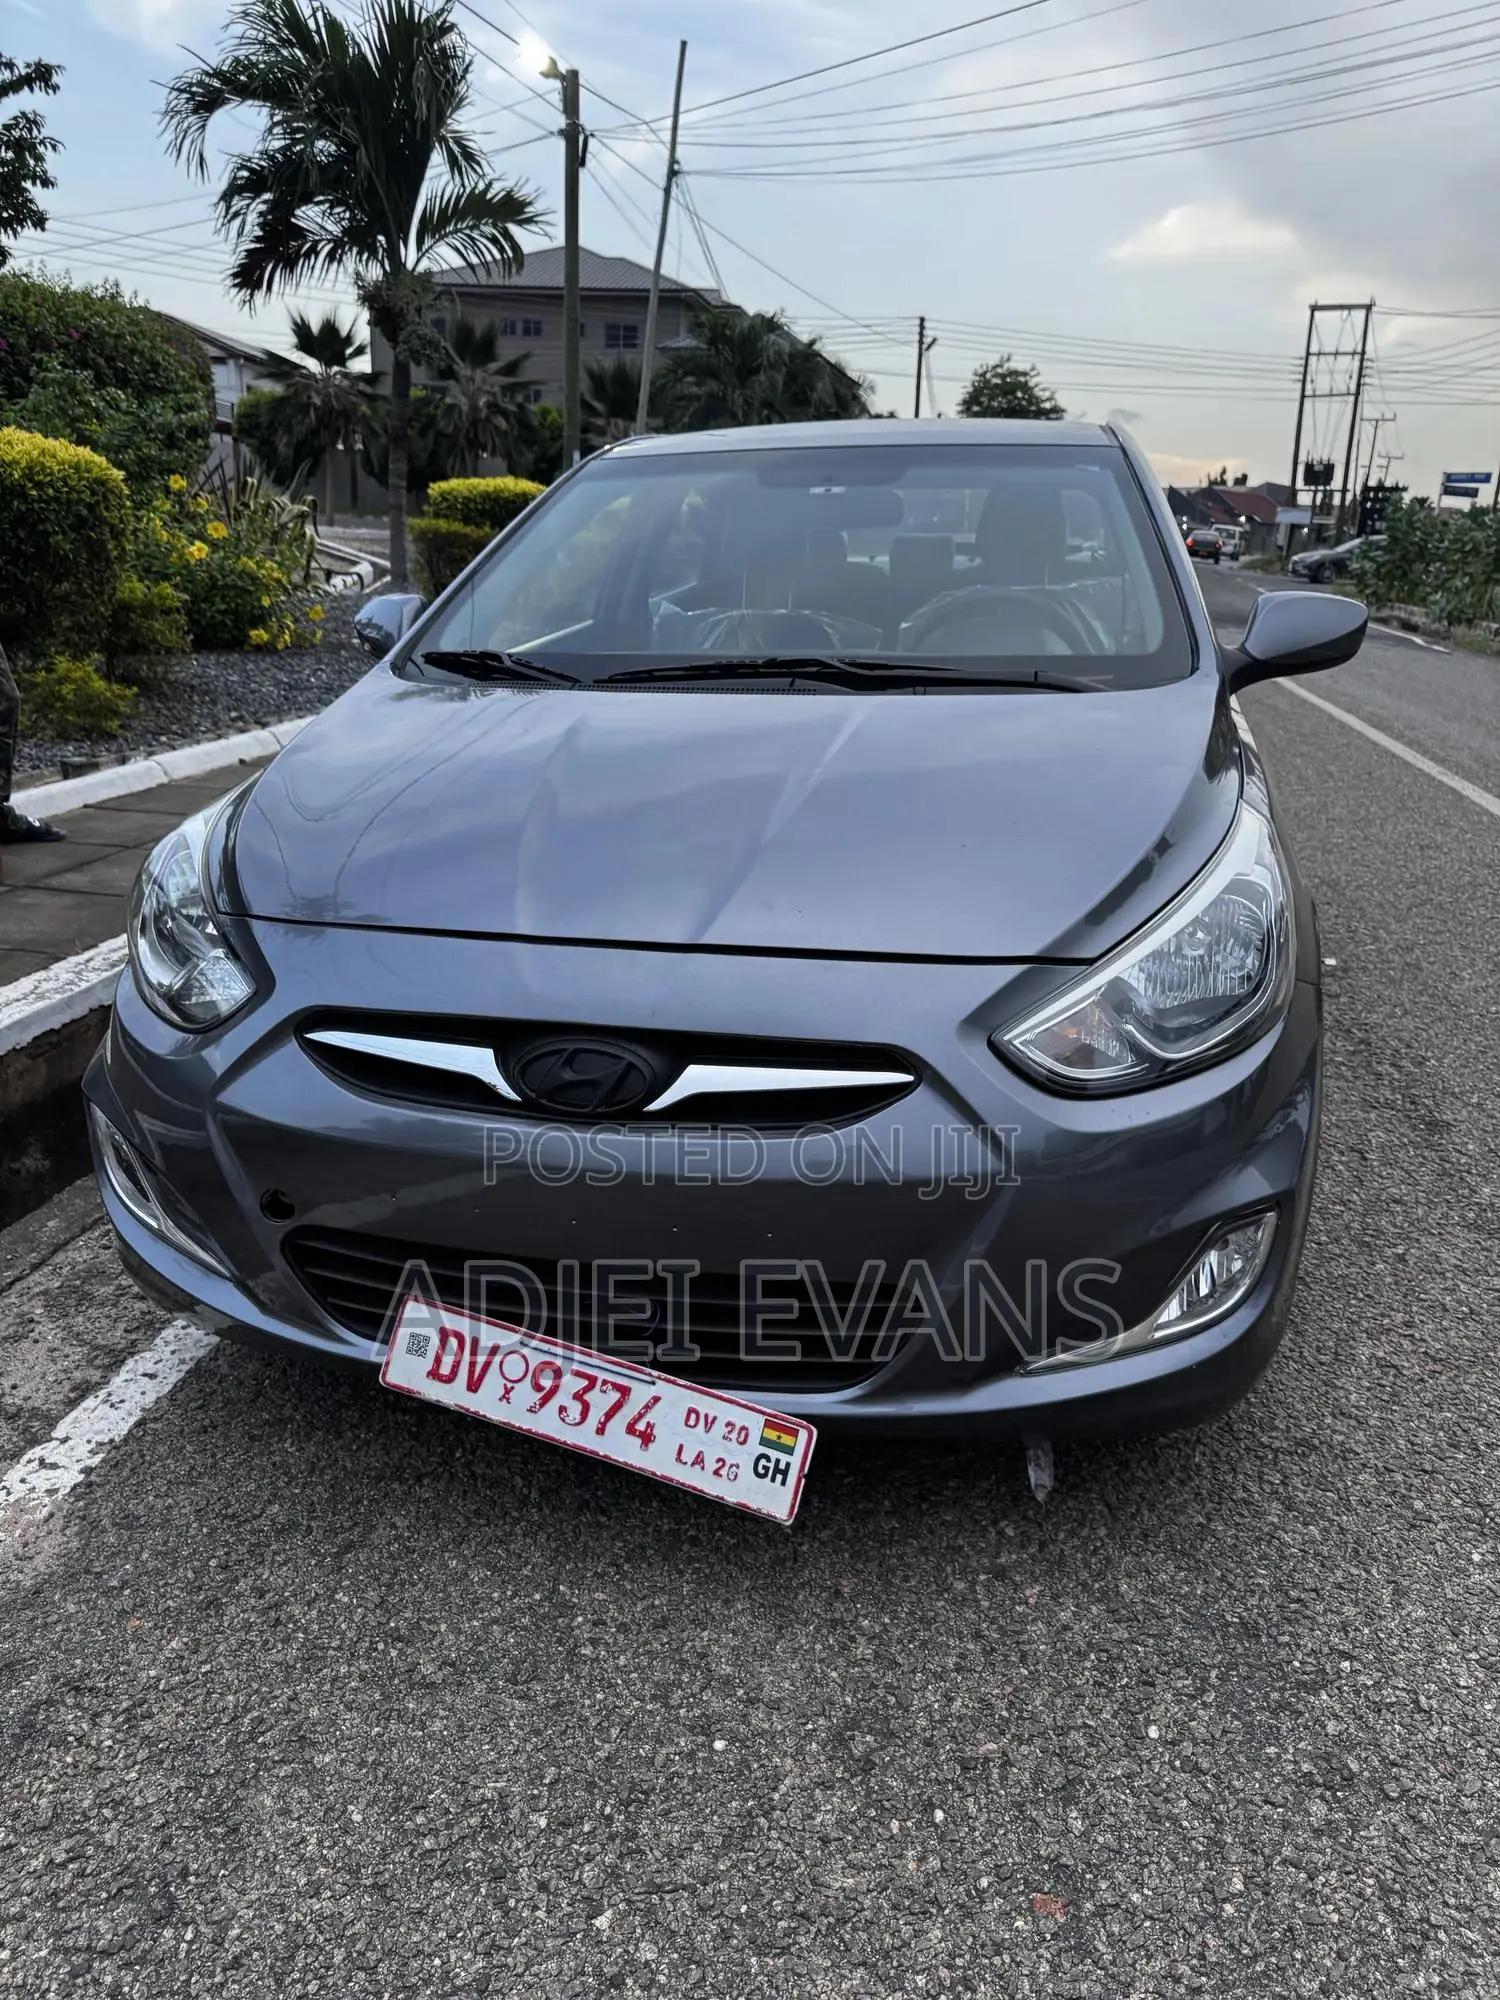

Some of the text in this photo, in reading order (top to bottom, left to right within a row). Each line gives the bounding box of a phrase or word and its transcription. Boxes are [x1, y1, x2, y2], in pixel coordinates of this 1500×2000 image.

[426, 1325, 662, 1452] DV 9374
[684, 1406, 750, 1446] DV 20
[675, 1443, 740, 1482] LA 26
[752, 1452, 792, 1488] GH
